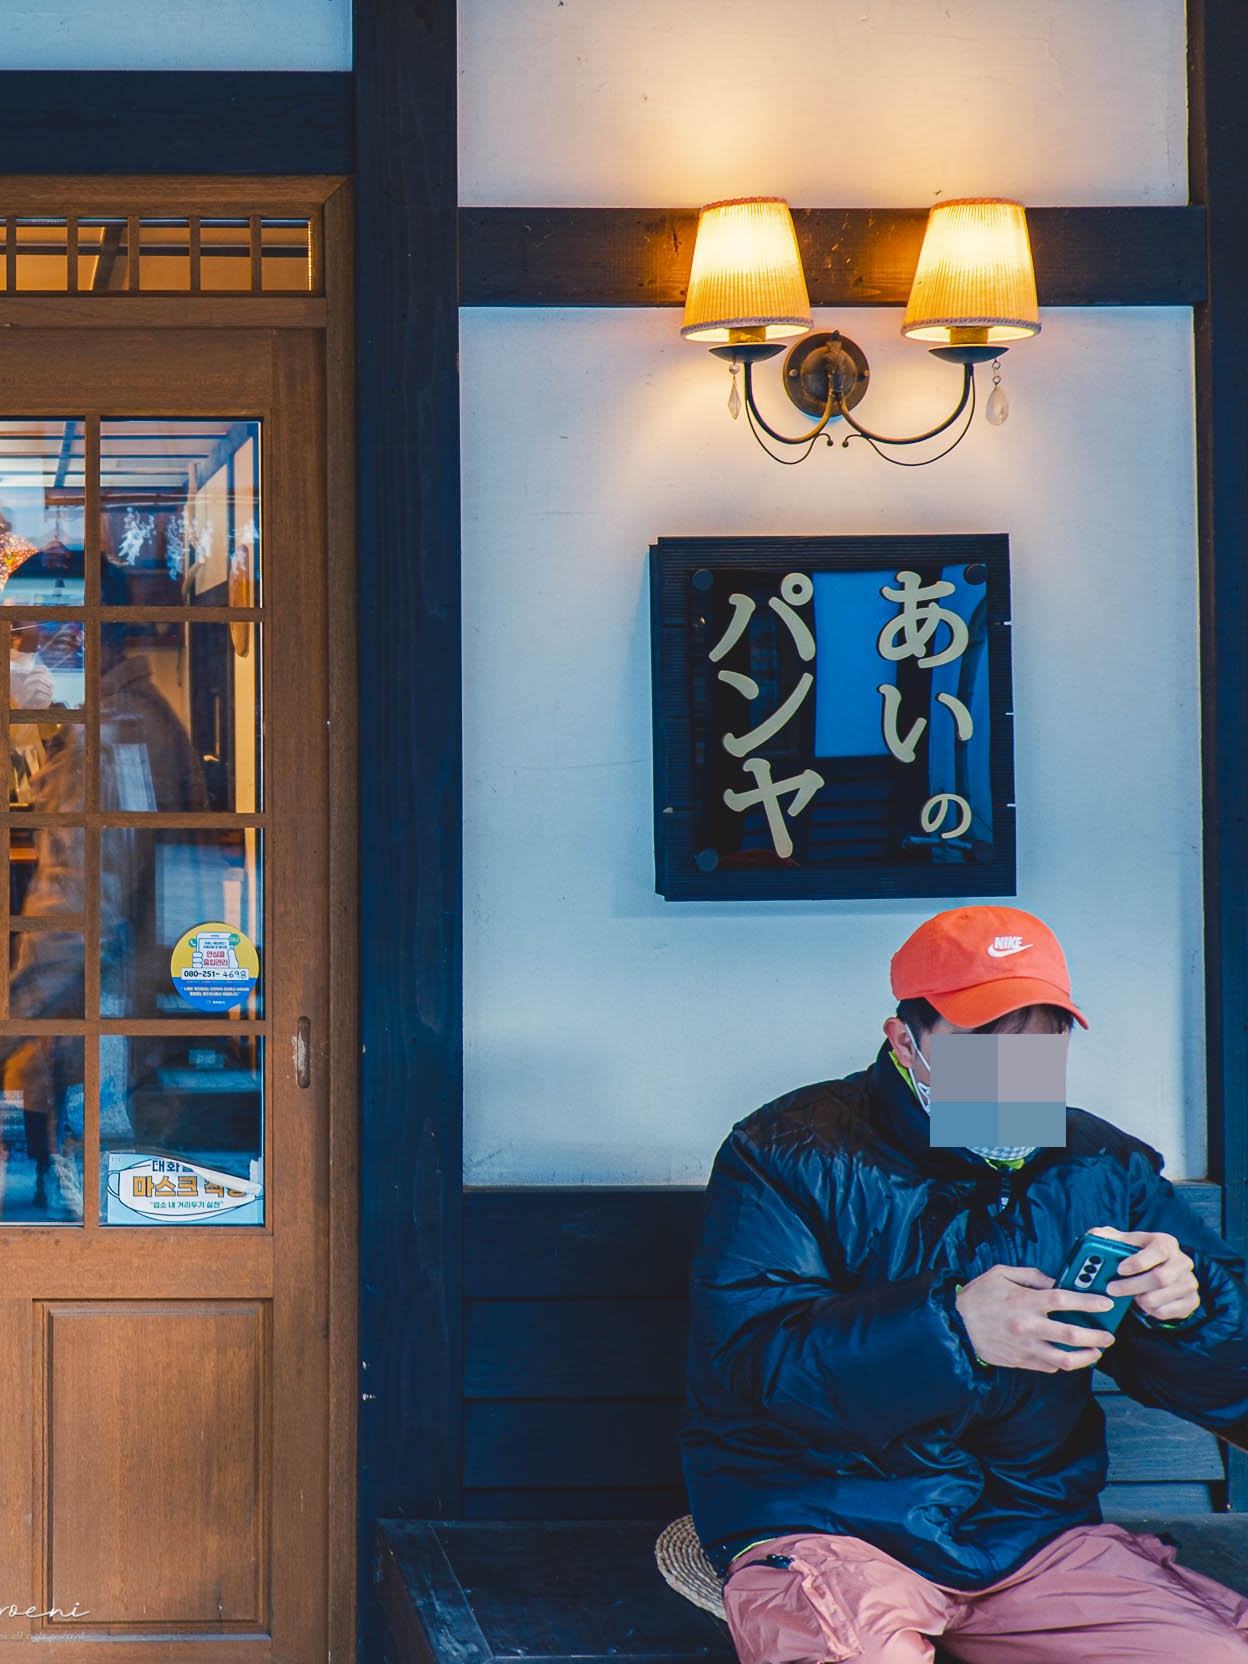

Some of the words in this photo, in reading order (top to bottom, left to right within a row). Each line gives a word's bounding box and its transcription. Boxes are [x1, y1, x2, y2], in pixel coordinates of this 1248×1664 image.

[708, 572, 825, 859] パンヤ
[878, 570, 974, 839] あいの
[994, 936, 1023, 950] NIKE
[133, 1176, 198, 1197] 마스크
